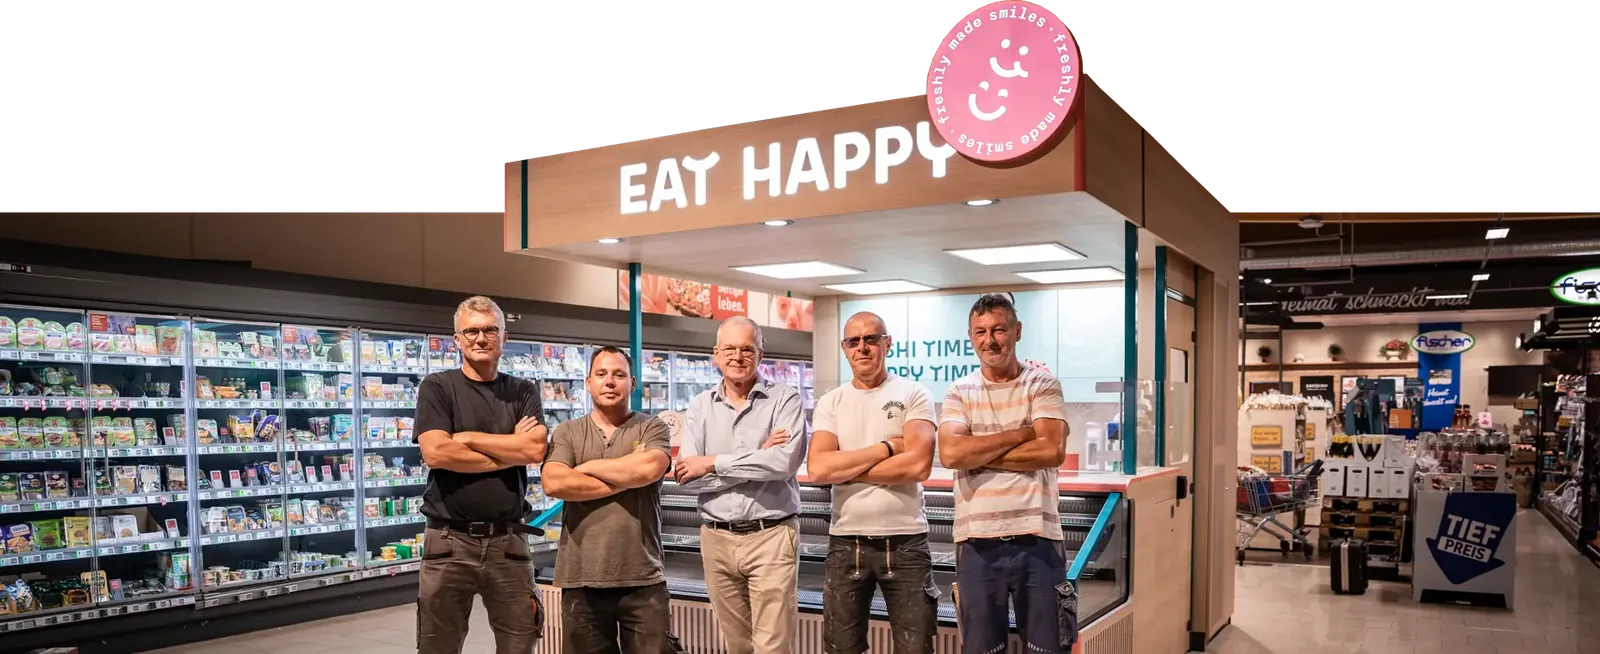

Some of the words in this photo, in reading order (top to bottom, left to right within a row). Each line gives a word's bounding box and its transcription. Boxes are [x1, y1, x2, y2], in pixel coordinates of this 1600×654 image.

[932, 55, 952, 125] freshly
[948, 18, 982, 51] made
[989, 5, 1046, 28] smiles
[1053, 33, 1074, 107] freshly
[1021, 111, 1056, 145] made
[958, 134, 1013, 156] smiles
[620, 151, 720, 215] EAT
[743, 121, 957, 201] HAPPY
[717, 295, 745, 312] leben.
[1281, 287, 1343, 312] eimat
[1345, 286, 1435, 312] schmeckt
[886, 340, 916, 358] SHI
[923, 339, 975, 357] TIME
[1416, 334, 1471, 348] fischer
[1447, 514, 1500, 545] TIEF
[1444, 538, 1486, 560] PREIS
